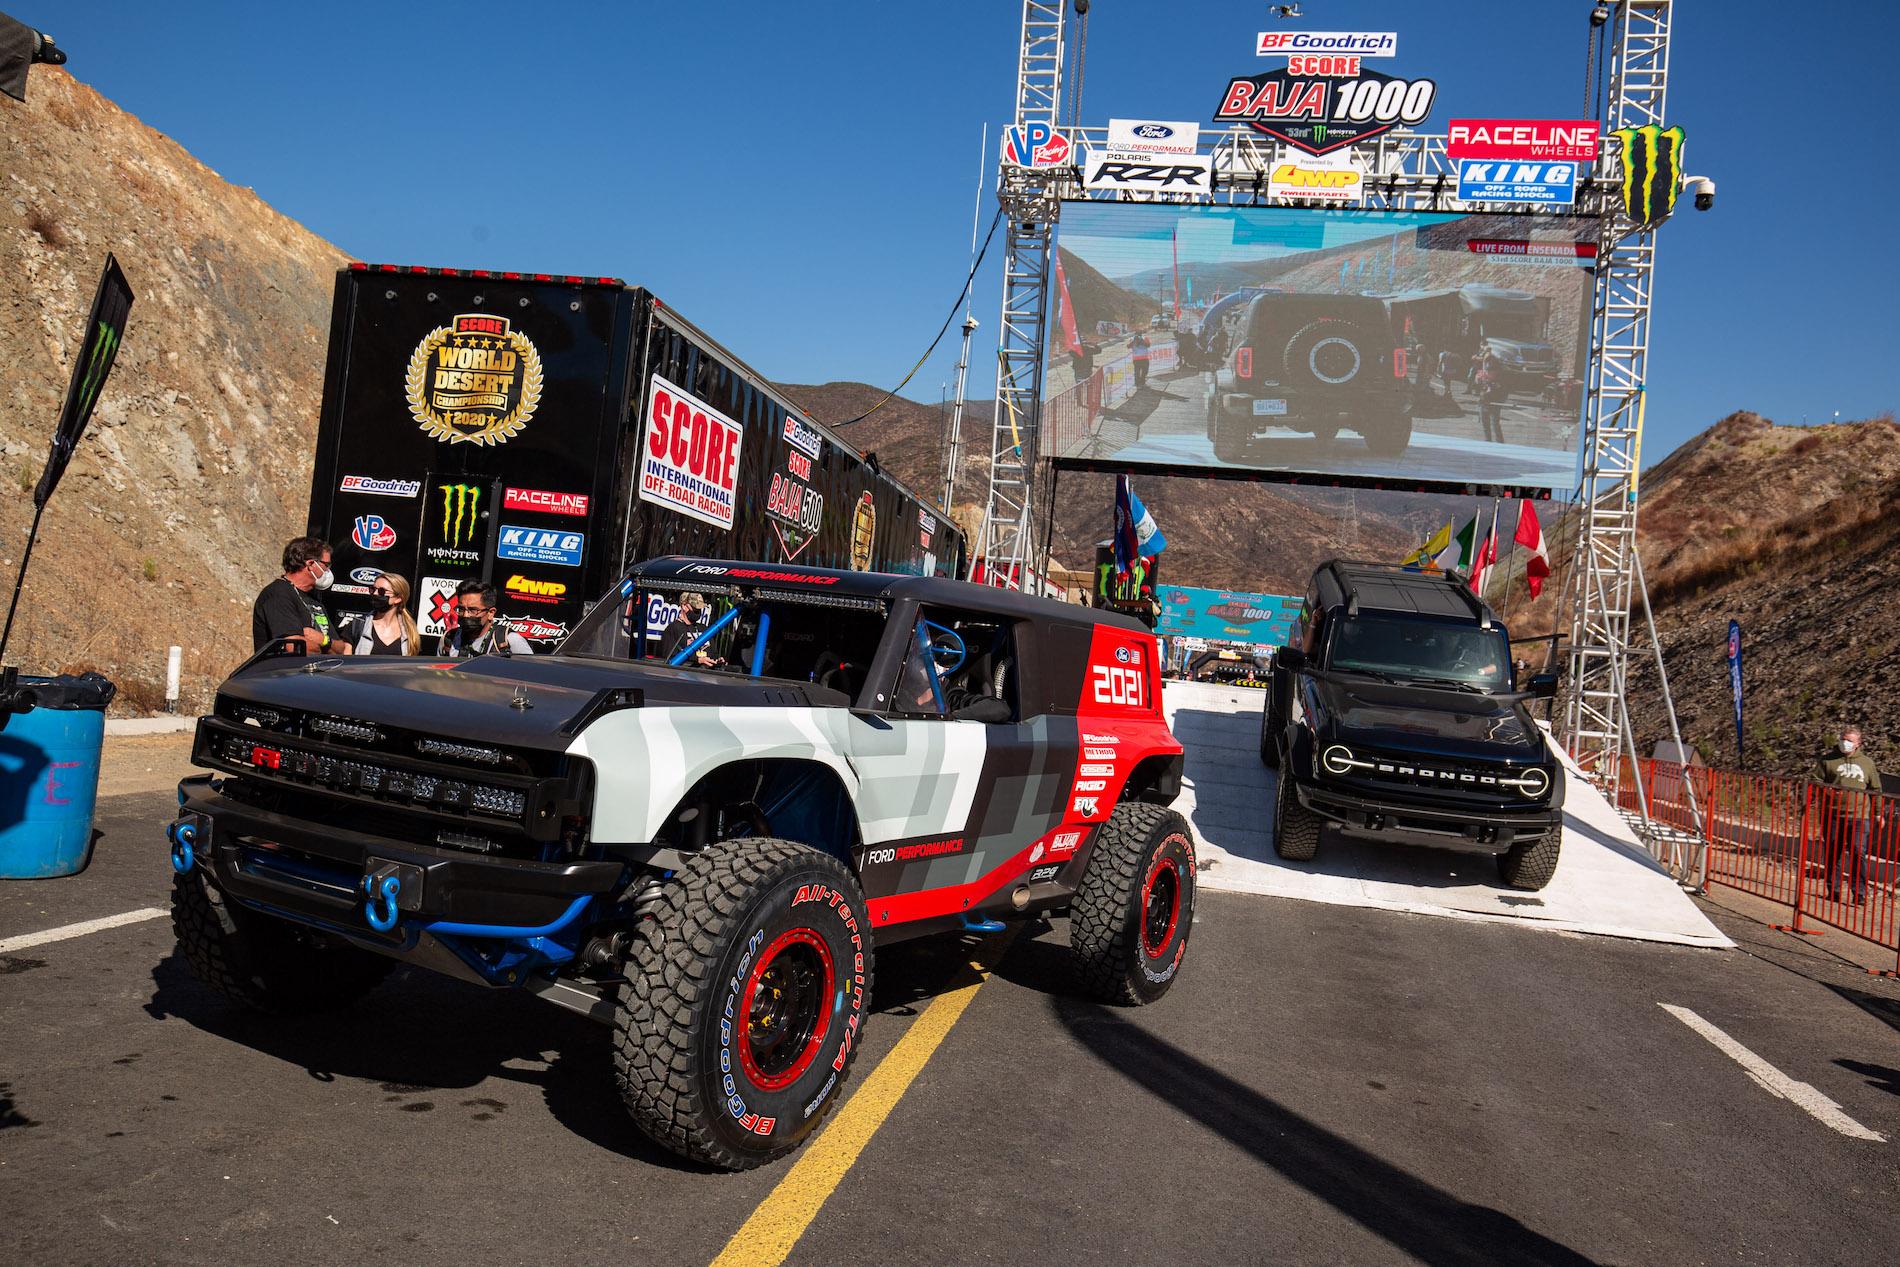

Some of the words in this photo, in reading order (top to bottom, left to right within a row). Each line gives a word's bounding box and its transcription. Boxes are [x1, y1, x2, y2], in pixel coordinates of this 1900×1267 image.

[1262, 34, 1393, 48] BFGoodrich
[1289, 56, 1361, 76] SCORE
[1219, 80, 1327, 117] BAJA
[1333, 79, 1436, 121] 1000
[1140, 125, 1167, 138] Ford
[1450, 127, 1596, 147] RACELINE
[1009, 122, 1051, 167] VP
[1036, 145, 1069, 161] Racing
[1109, 143, 1131, 151] FORD
[1131, 144, 1195, 154] PERFORMANCE
[1531, 146, 1594, 157] WHEELS
[1091, 163, 1207, 186] RZR
[1272, 165, 1360, 188] 4WP
[1462, 164, 1572, 183] KING
[1476, 244, 1496, 253] LIVE
[1498, 245, 1525, 254] FROM
[1527, 245, 1577, 255] ENSENADA
[460, 318, 502, 333] SCORE
[439, 347, 516, 371] WORLD
[434, 370, 514, 393] DESERT
[436, 396, 505, 406] CHAMPIONSHIP
[453, 412, 486, 426] 2020
[650, 390, 738, 490] SCORE
[785, 418, 821, 453] BFGoodrich
[789, 450, 811, 482] SCORE
[343, 476, 419, 492] BFGoodrich
[647, 459, 731, 506] INTERNATIONAL
[506, 489, 586, 508] RACELINE
[645, 474, 695, 505] OFF-ROAD
[698, 496, 731, 519] RACING
[768, 473, 802, 522] BAJA
[801, 488, 823, 533] 500
[550, 505, 585, 515] WHEELS
[355, 515, 385, 549] VP
[502, 529, 580, 550] KING
[427, 547, 479, 561] MONSTER
[434, 558, 472, 566] ENERGY
[506, 575, 566, 596] 4WP
[690, 566, 728, 576] FORD
[724, 569, 840, 585] PERFORMANCE
[1243, 608, 1272, 620] 1000
[530, 624, 564, 637] Open
[1093, 665, 1142, 706] 2021
[1083, 734, 1119, 742] BFGoodrich
[1379, 764, 1496, 784] BRONCO
[1075, 781, 1106, 791] RIGID
[1073, 797, 1099, 812] FOX
[868, 848, 895, 865] FORD
[895, 839, 963, 860] PERFORMANCE
[791, 884, 865, 1011] All-Terrain
[832, 1013, 860, 1072] T/A
[720, 929, 776, 1136] BFGoodrich
